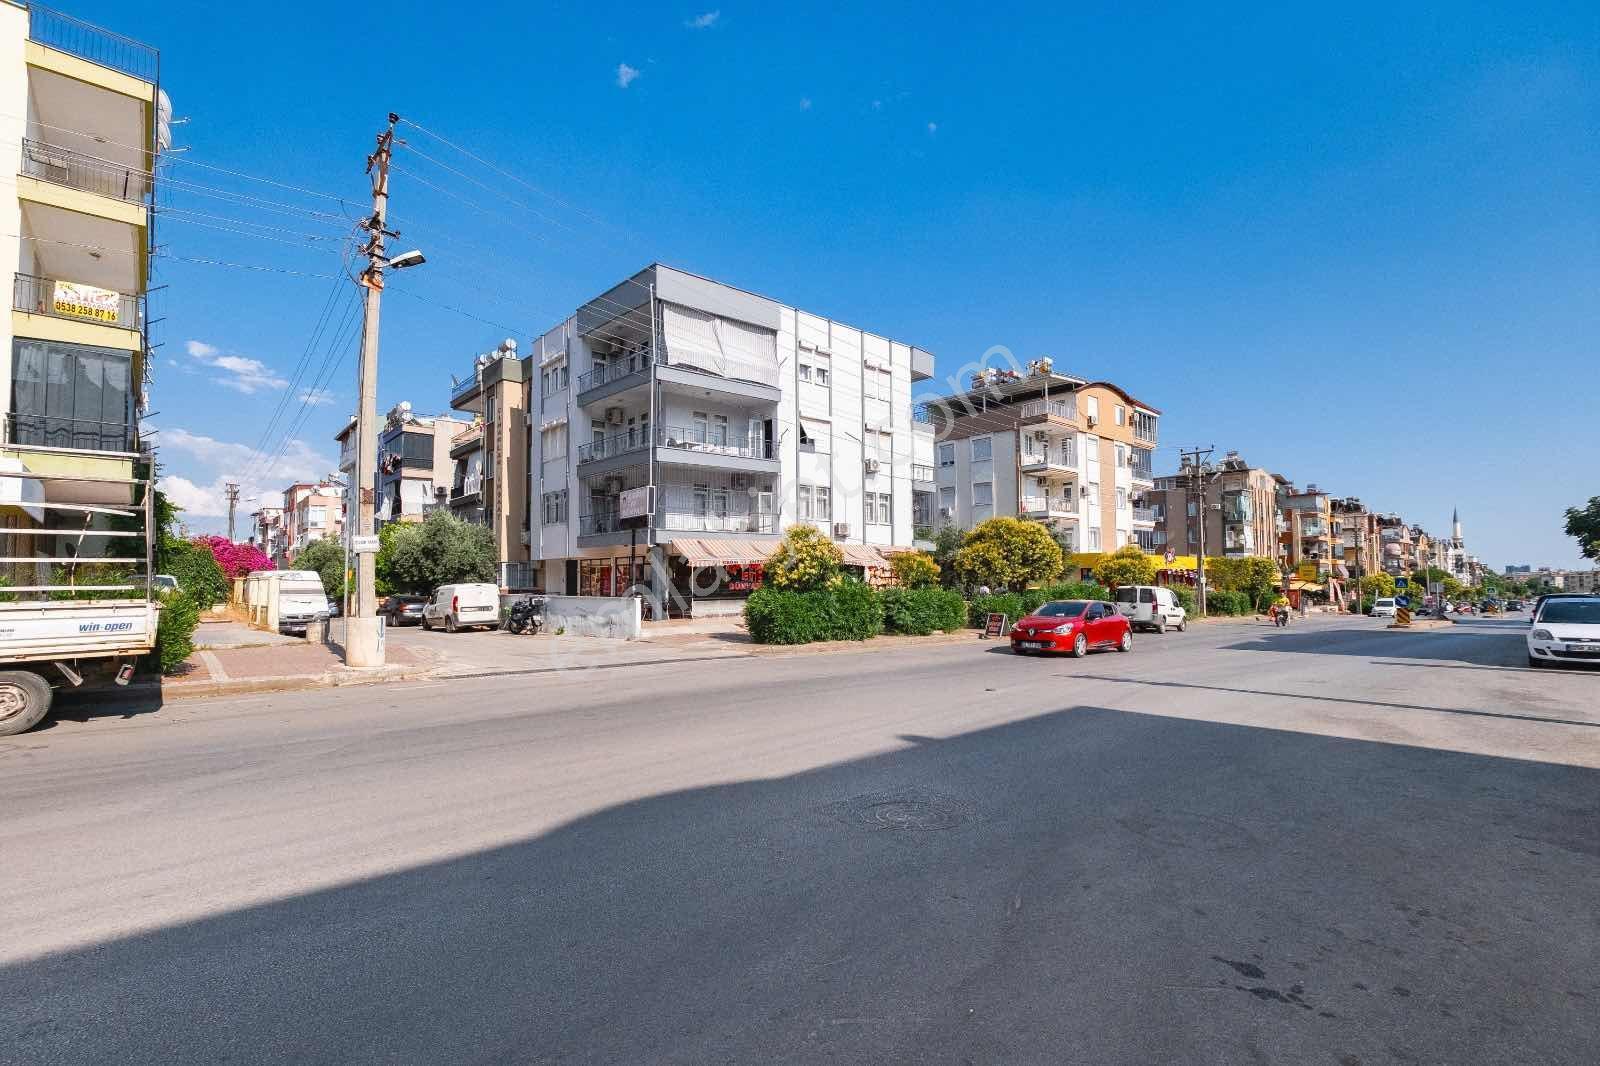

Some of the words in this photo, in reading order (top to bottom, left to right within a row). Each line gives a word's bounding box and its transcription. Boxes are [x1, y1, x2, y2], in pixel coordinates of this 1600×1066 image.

[78, 305, 93, 316] 258
[95, 308, 105, 319] 87
[79, 621, 133, 632] win-open
